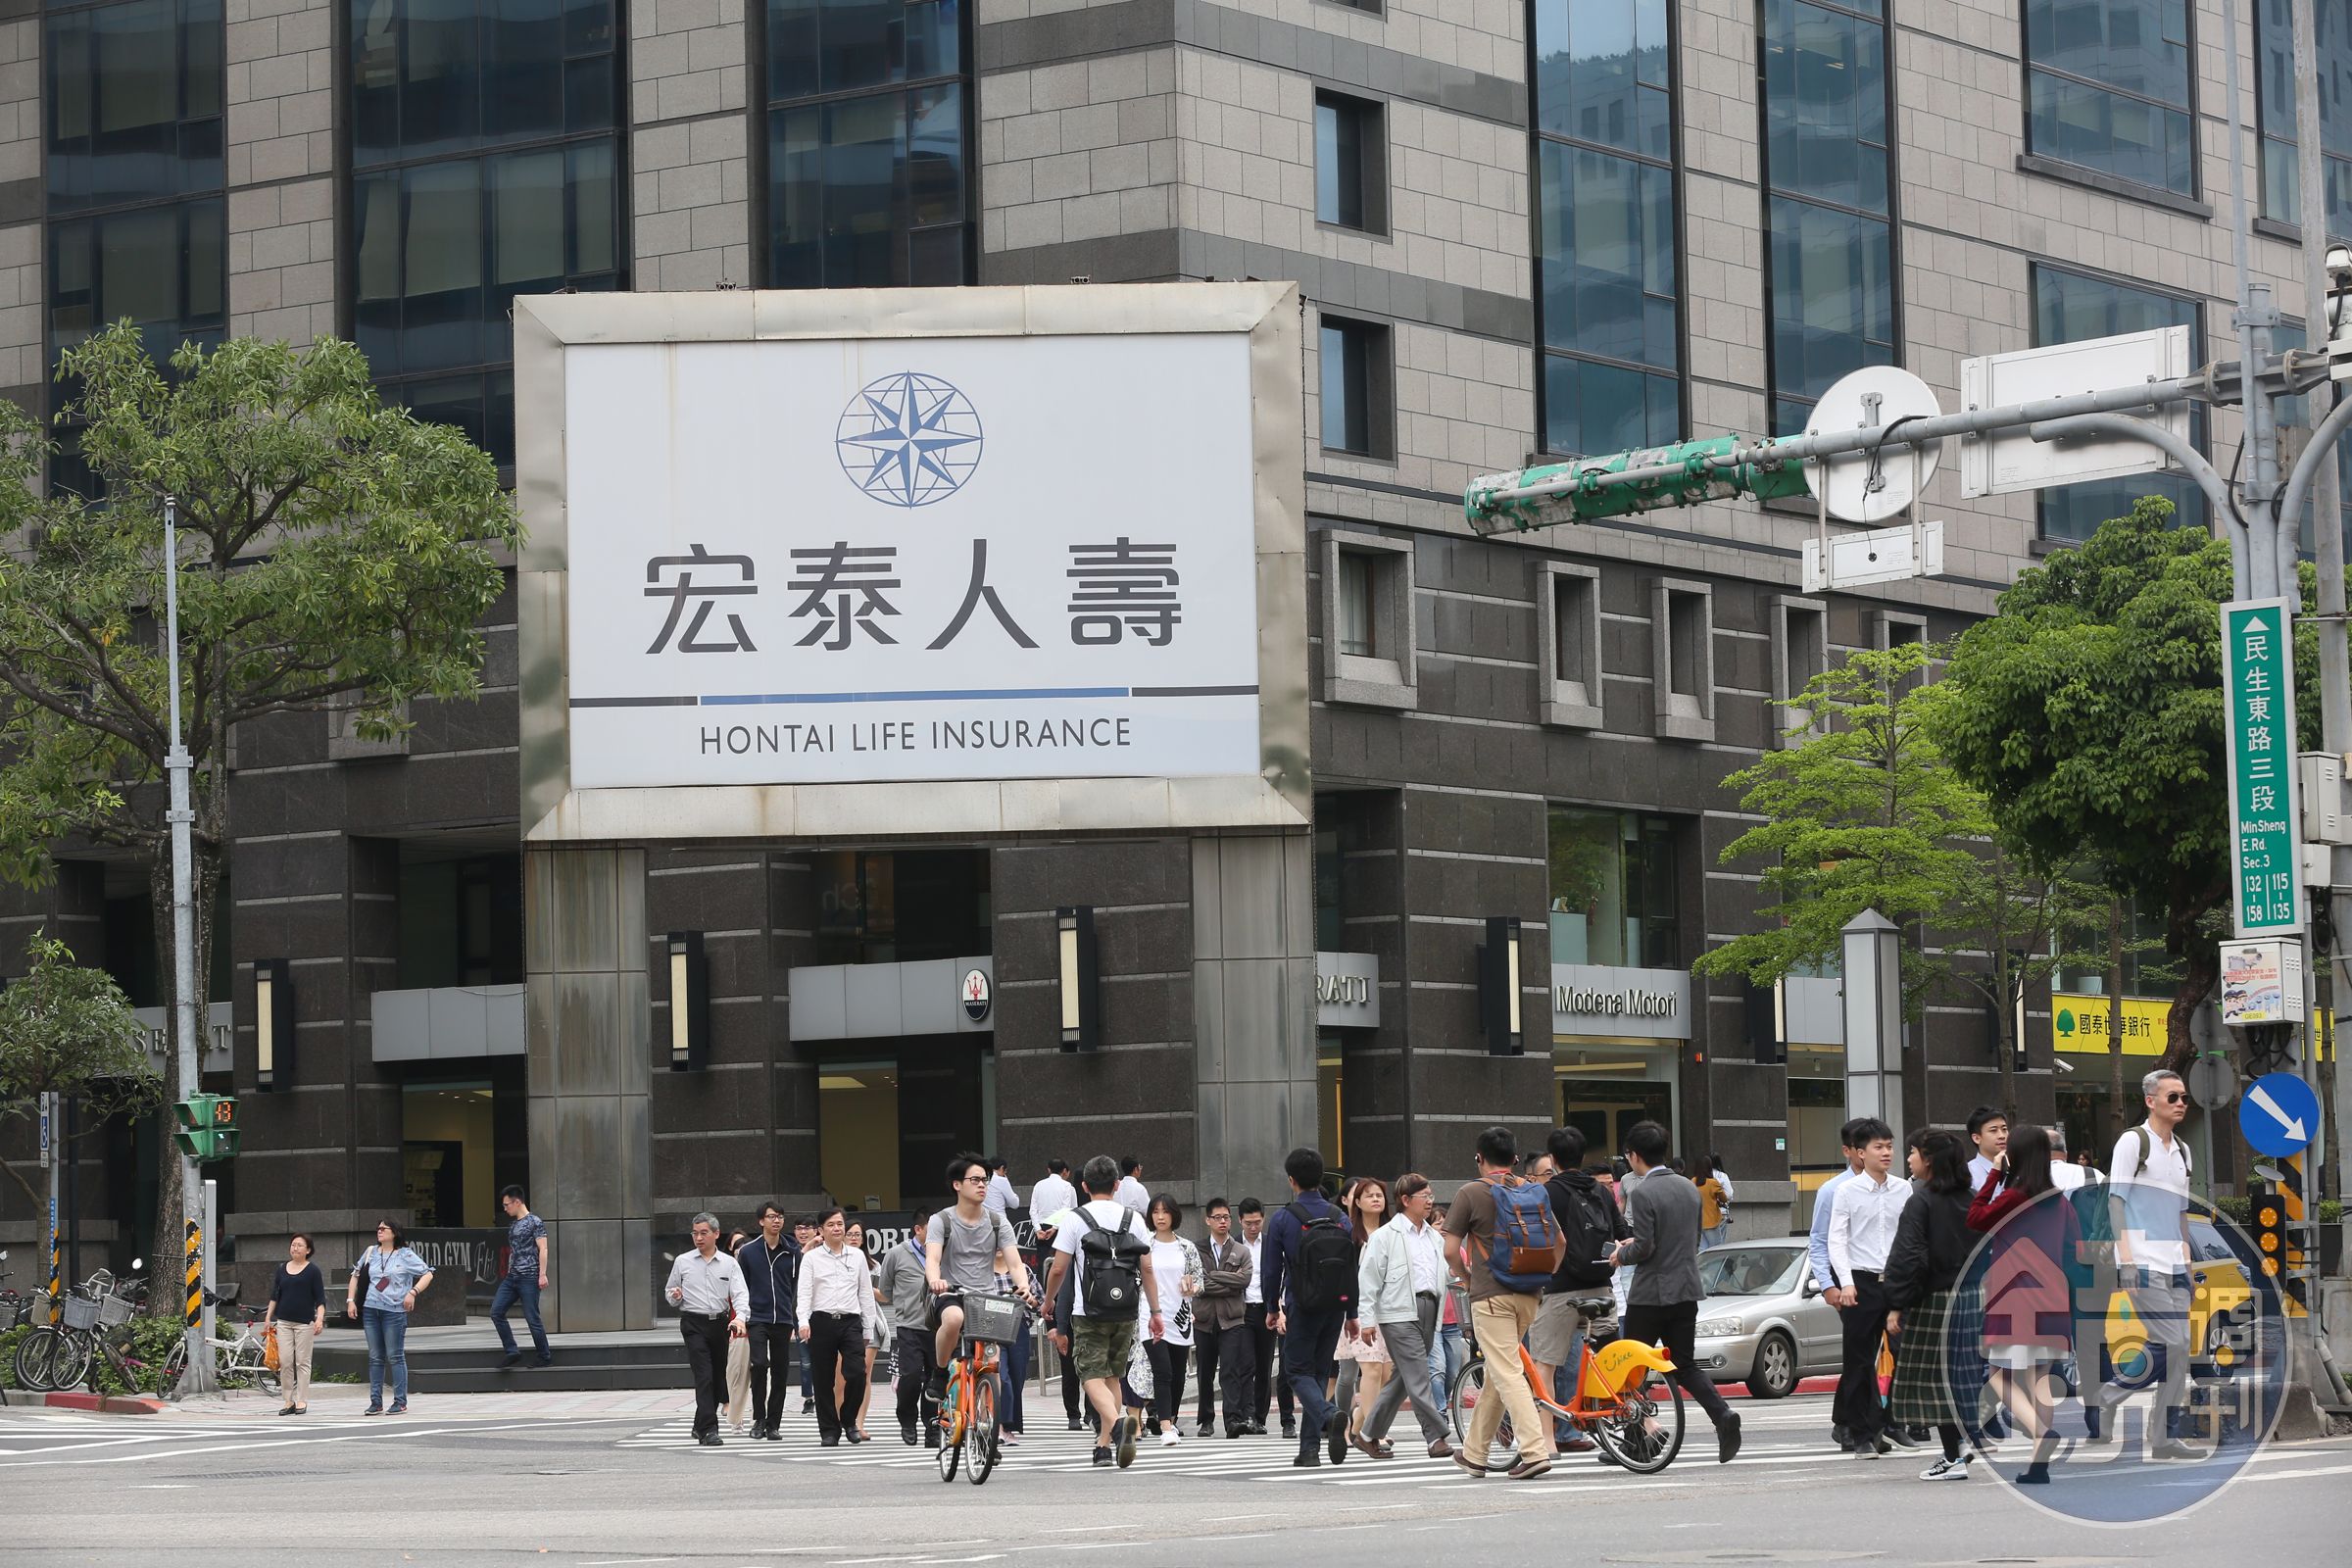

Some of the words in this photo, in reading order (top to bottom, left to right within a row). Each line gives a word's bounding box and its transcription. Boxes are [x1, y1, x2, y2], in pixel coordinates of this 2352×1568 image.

[644, 537, 1181, 655] 宏泰人壽
[701, 724, 834, 755] HONTAI
[853, 721, 915, 752] LIFE
[932, 717, 1131, 750] INSURANCE
[2244, 636, 2275, 812] 民生東路三段
[2245, 875, 2262, 893] 132
[2273, 873, 2289, 890] 115
[2246, 905, 2263, 922] 158
[2274, 903, 2290, 920] 135
[1316, 975, 1371, 1004] RATI
[1555, 986, 1623, 1014] Modena
[1625, 989, 1677, 1016] Motori
[406, 1241, 441, 1266] RLD
[444, 1241, 471, 1272] GYM
[1173, 1298, 1191, 1330] NIKE
